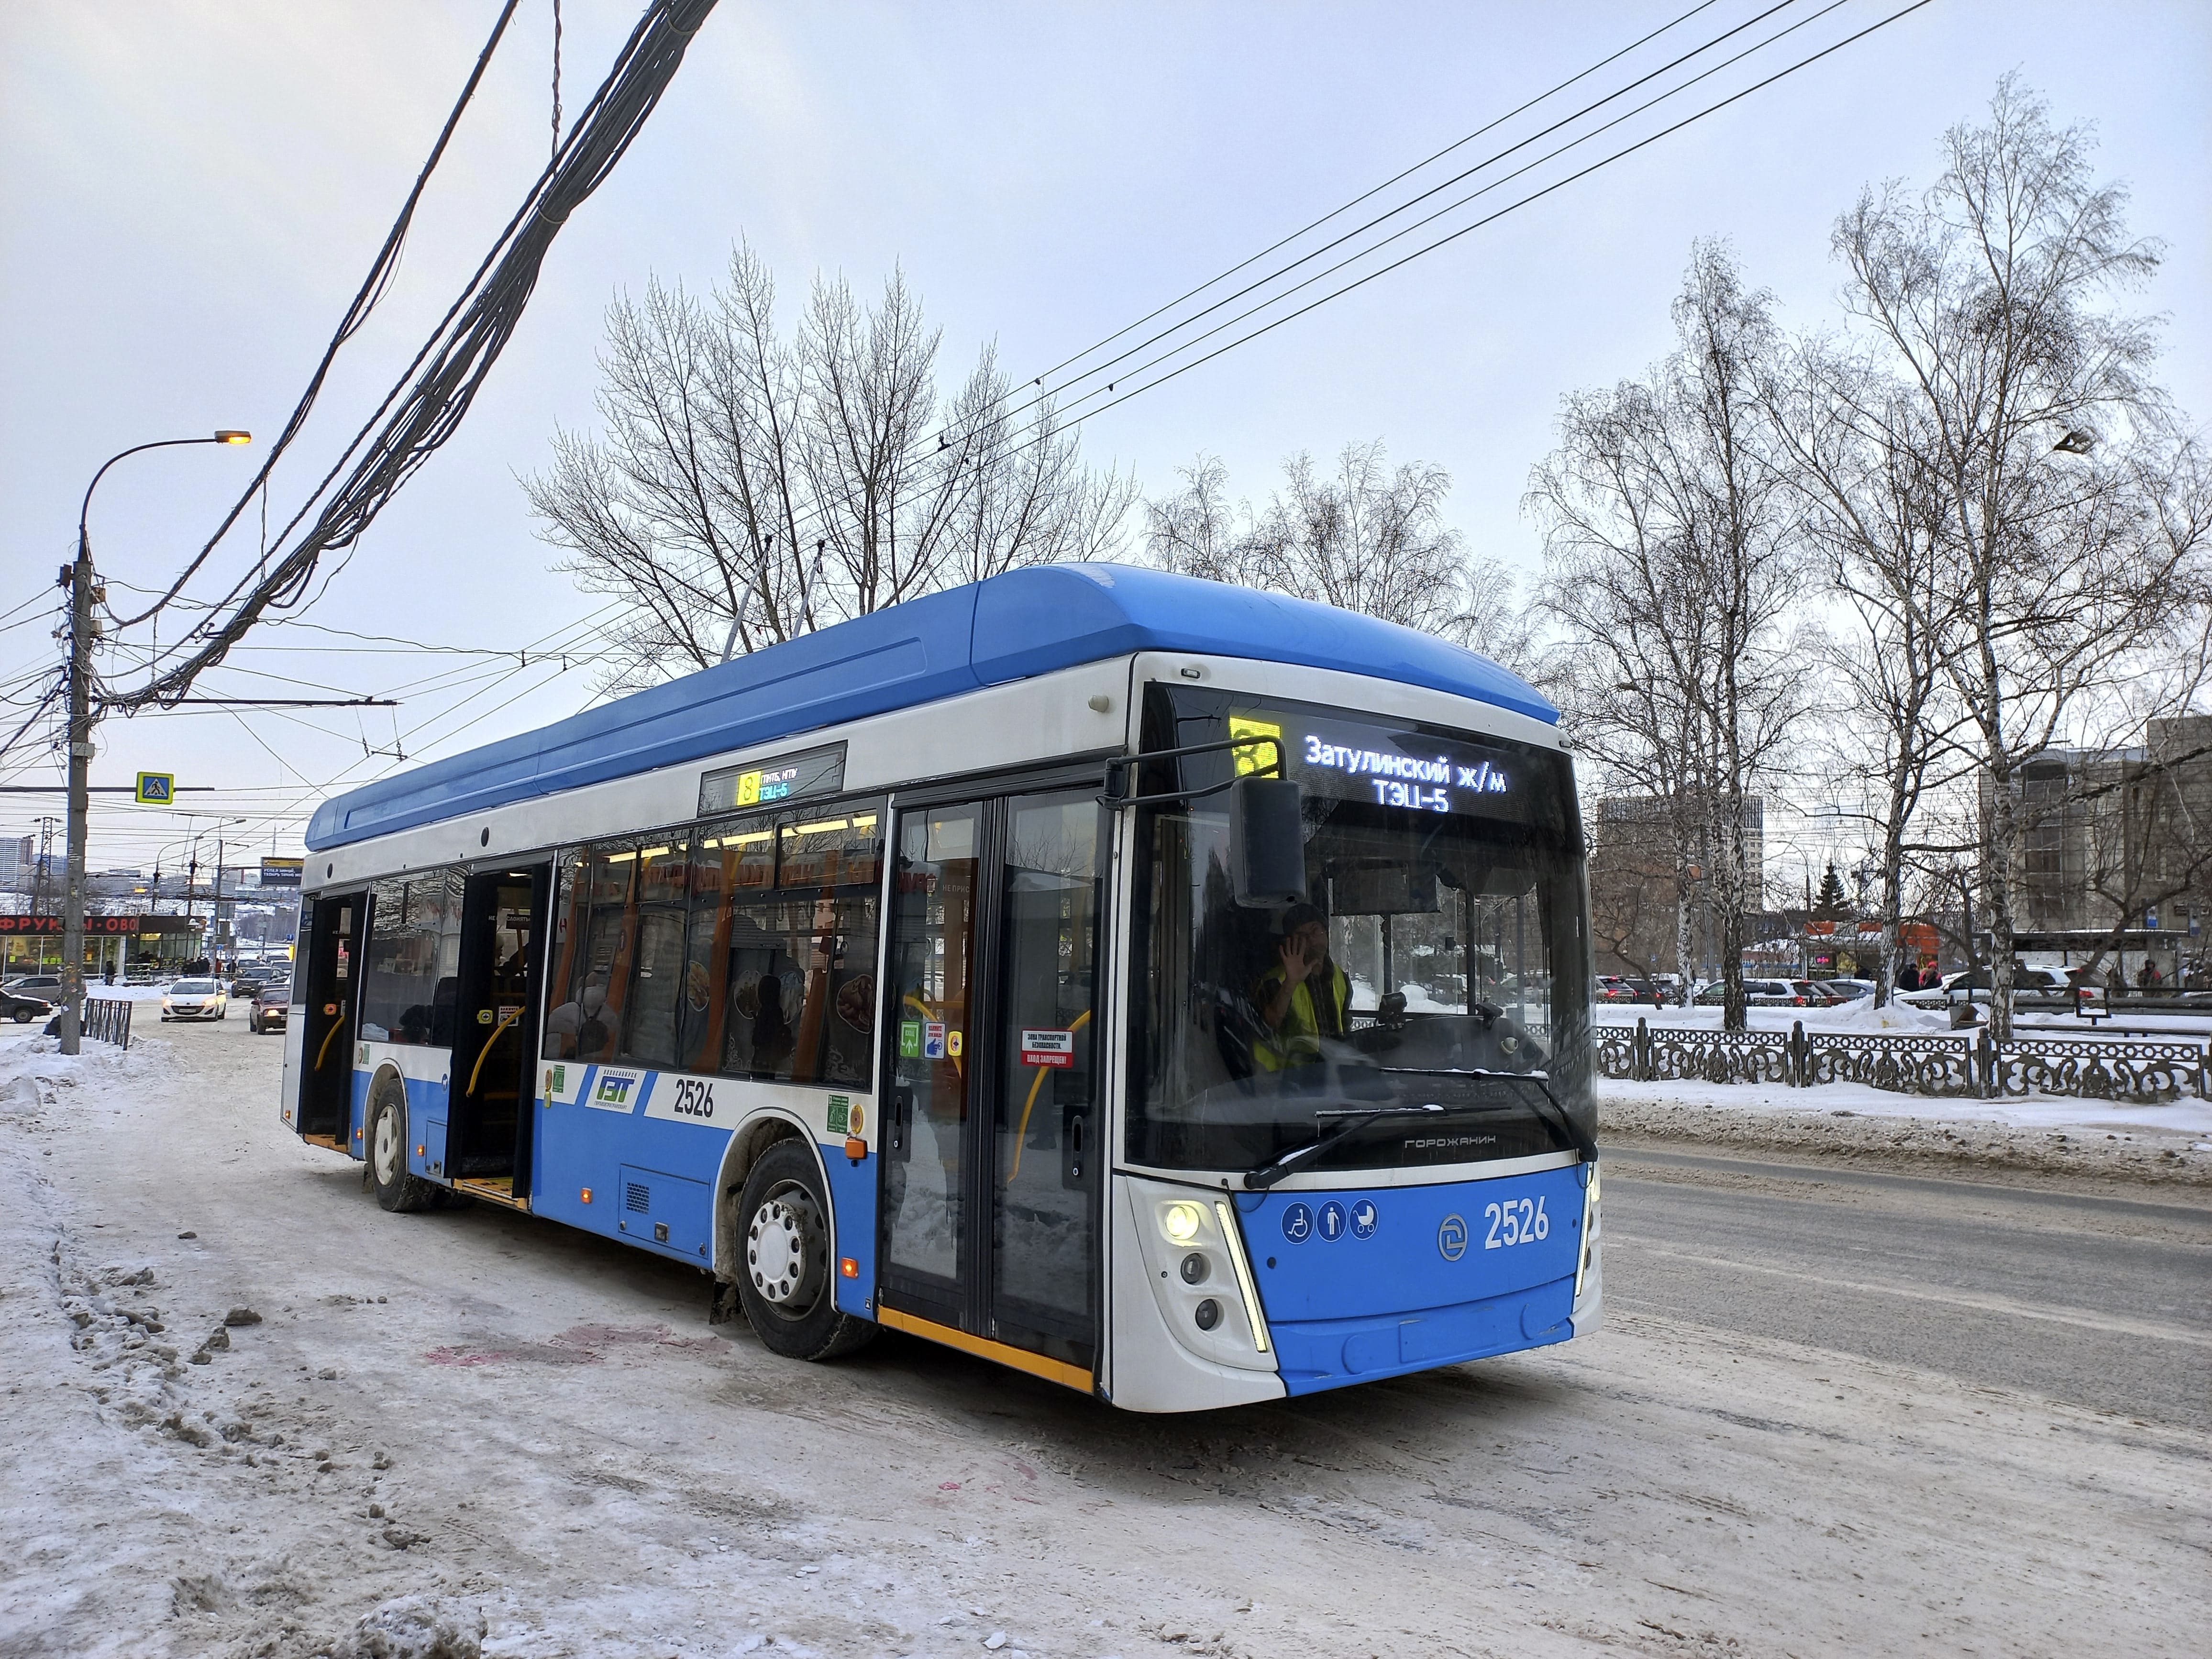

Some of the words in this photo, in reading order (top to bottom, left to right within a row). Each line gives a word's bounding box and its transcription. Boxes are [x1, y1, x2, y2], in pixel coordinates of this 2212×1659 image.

[1234, 728, 1259, 777] 8
[1305, 735, 1451, 784] Затулинский
[1458, 761, 1507, 792] ж/м
[743, 776, 753, 801] 8
[759, 782, 788, 801] ТЭЦ-5
[1372, 779, 1450, 813] ТЭЦ-5
[0, 918, 92, 930] ФРУКЫ
[1027, 1054, 1040, 1064] ВХОД
[1040, 1055, 1067, 1065] ЗАПРЕЩЕН!
[674, 1079, 713, 1118] 2526
[1405, 1135, 1496, 1149] ГОРОЖАНИН
[1485, 1195, 1549, 1250] 2526
